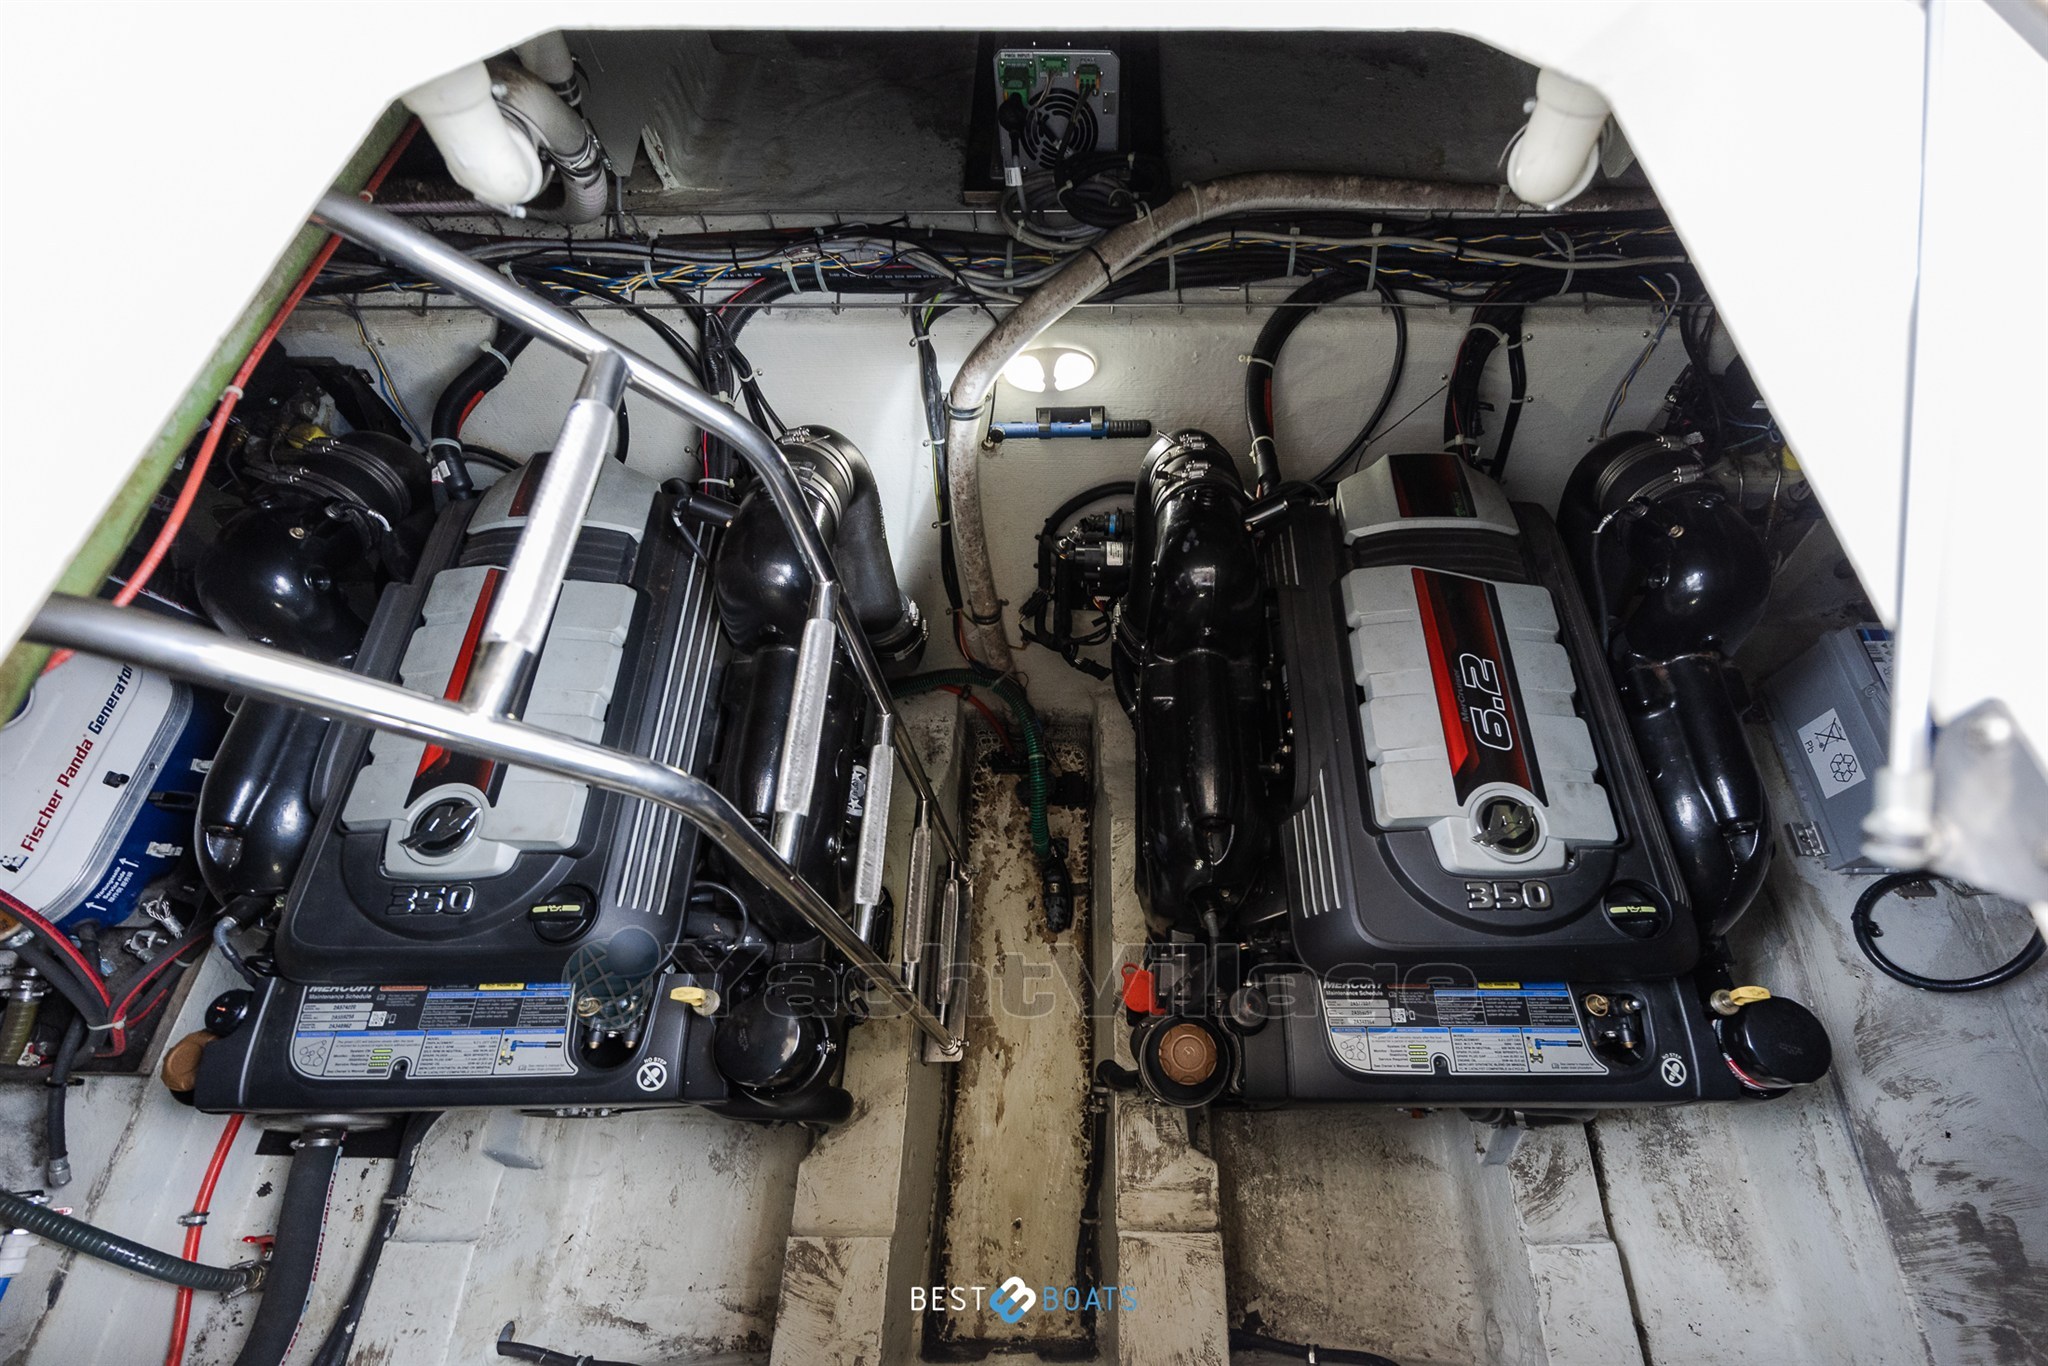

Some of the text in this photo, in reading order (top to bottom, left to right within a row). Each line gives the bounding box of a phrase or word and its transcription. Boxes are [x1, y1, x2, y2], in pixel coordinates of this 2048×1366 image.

[1460, 653, 1513, 751] 6.2
[1804, 740, 1815, 754] Pb
[20, 789, 64, 852] Fischer
[386, 884, 475, 915] 350
[1465, 880, 1553, 911] 350
